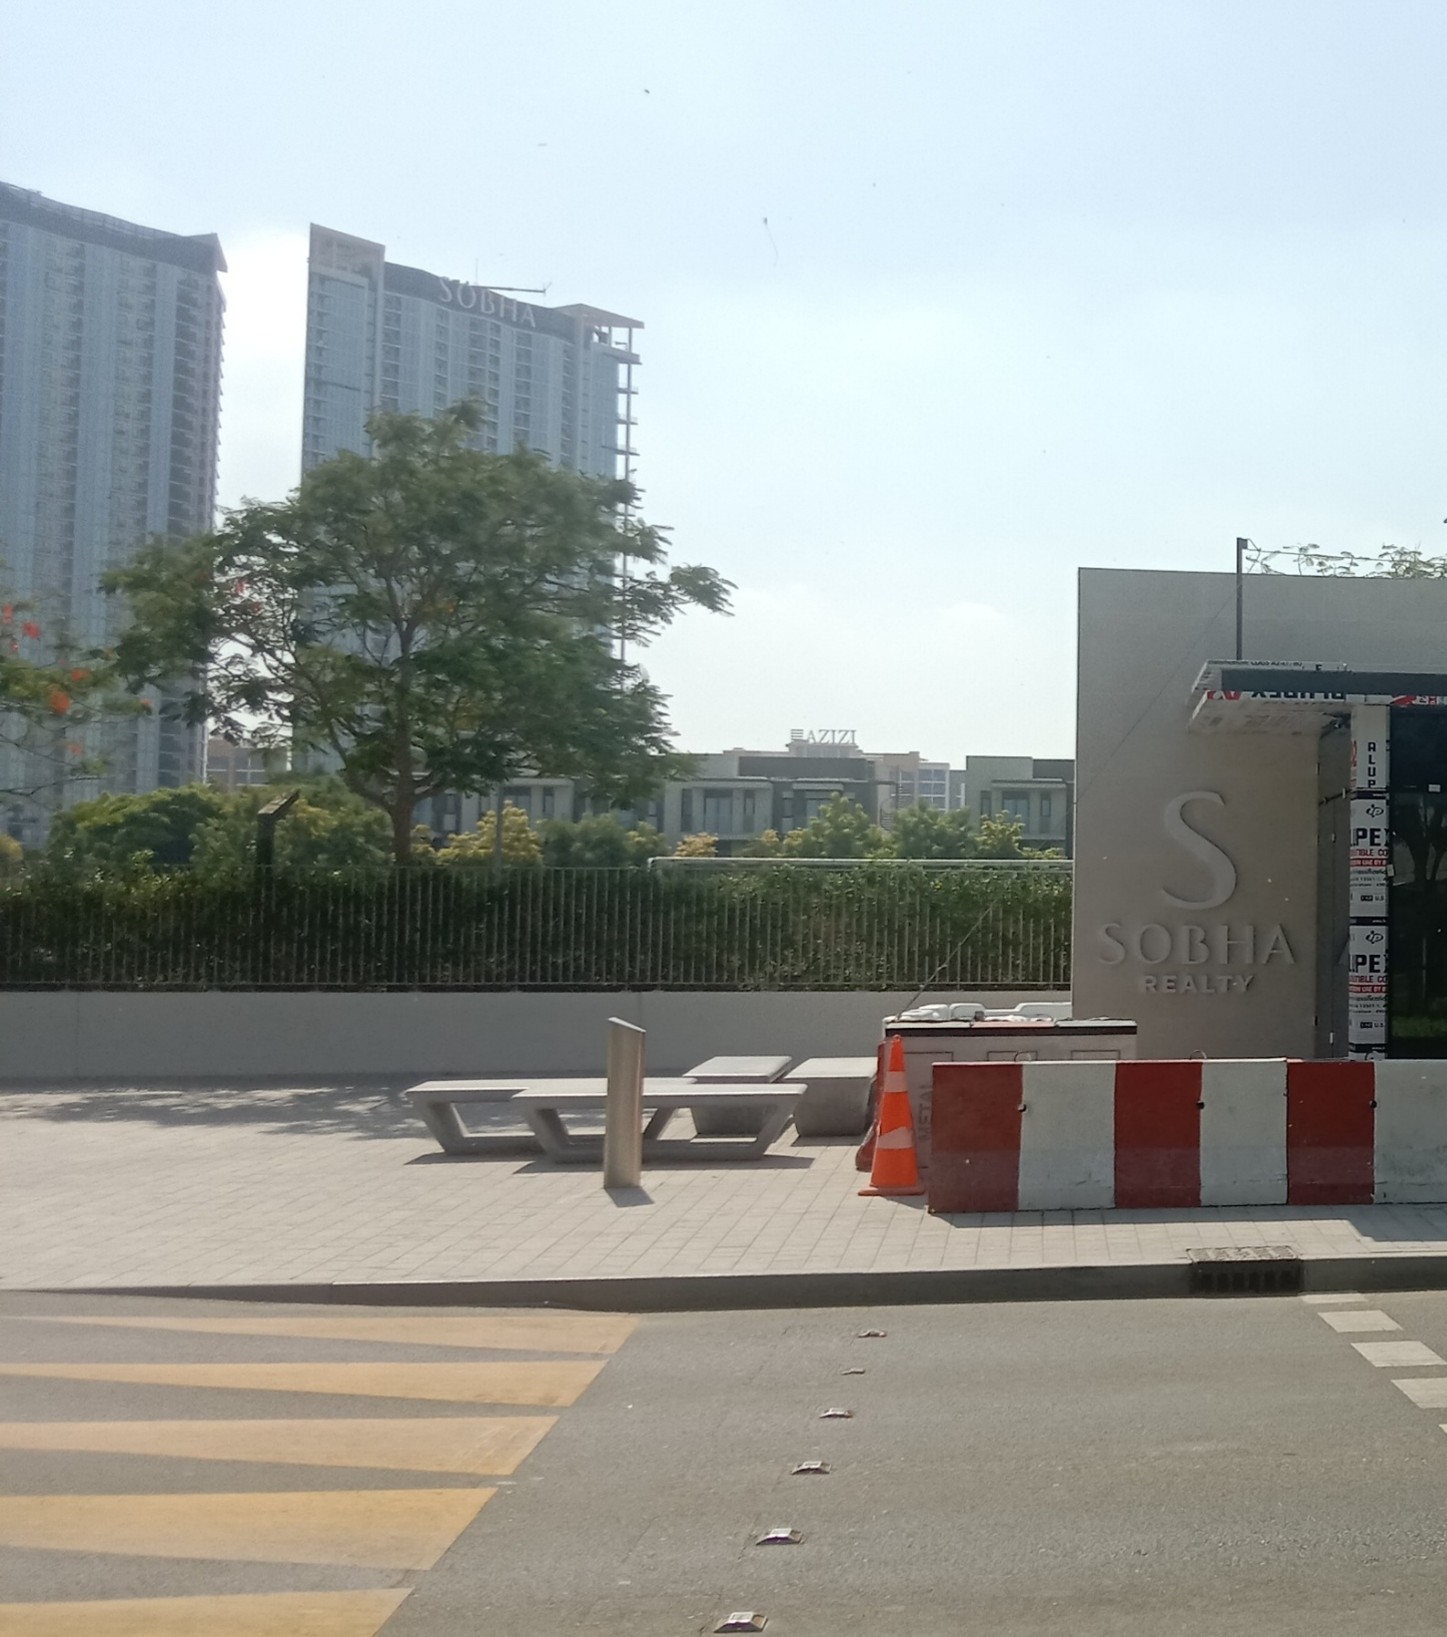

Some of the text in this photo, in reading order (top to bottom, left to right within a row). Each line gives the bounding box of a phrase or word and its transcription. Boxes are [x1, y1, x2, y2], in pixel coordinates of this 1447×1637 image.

[440, 278, 536, 328] SOBHA
[807, 729, 857, 745] AZIZI
[1161, 790, 1238, 910] S
[1098, 922, 1297, 965] SOBHA
[1141, 975, 1256, 993] REALTY
